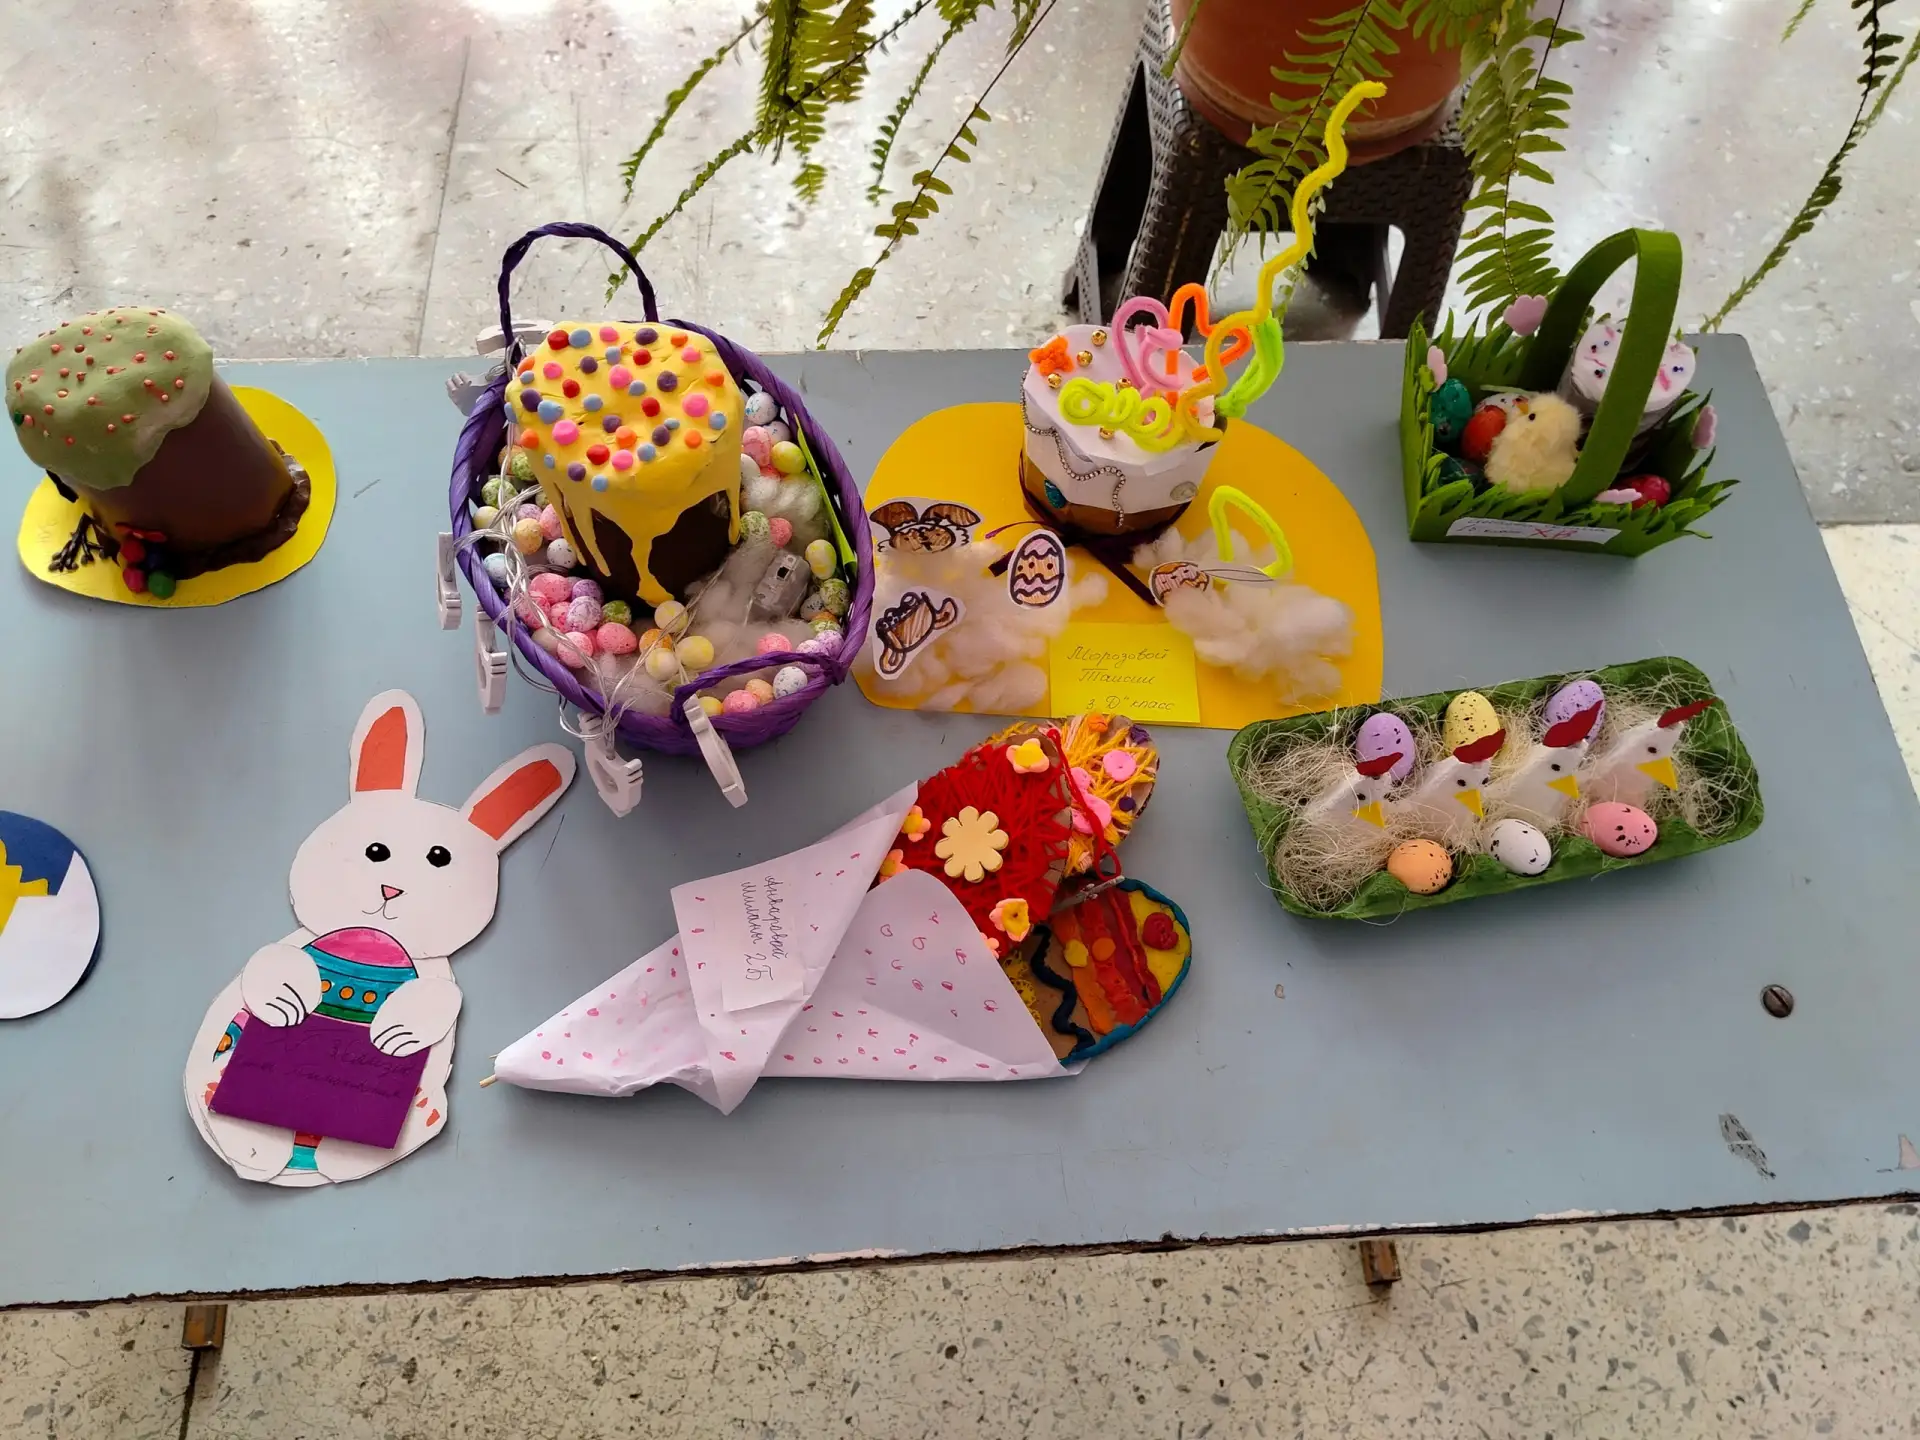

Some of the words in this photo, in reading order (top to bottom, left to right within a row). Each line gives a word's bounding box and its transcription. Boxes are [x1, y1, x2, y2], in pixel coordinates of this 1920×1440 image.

[1067, 645, 1169, 668] Морозовой
[1078, 668, 1155, 685] Таисии
[1130, 700, 1176, 711] класс
[741, 881, 763, 945] Миланы
